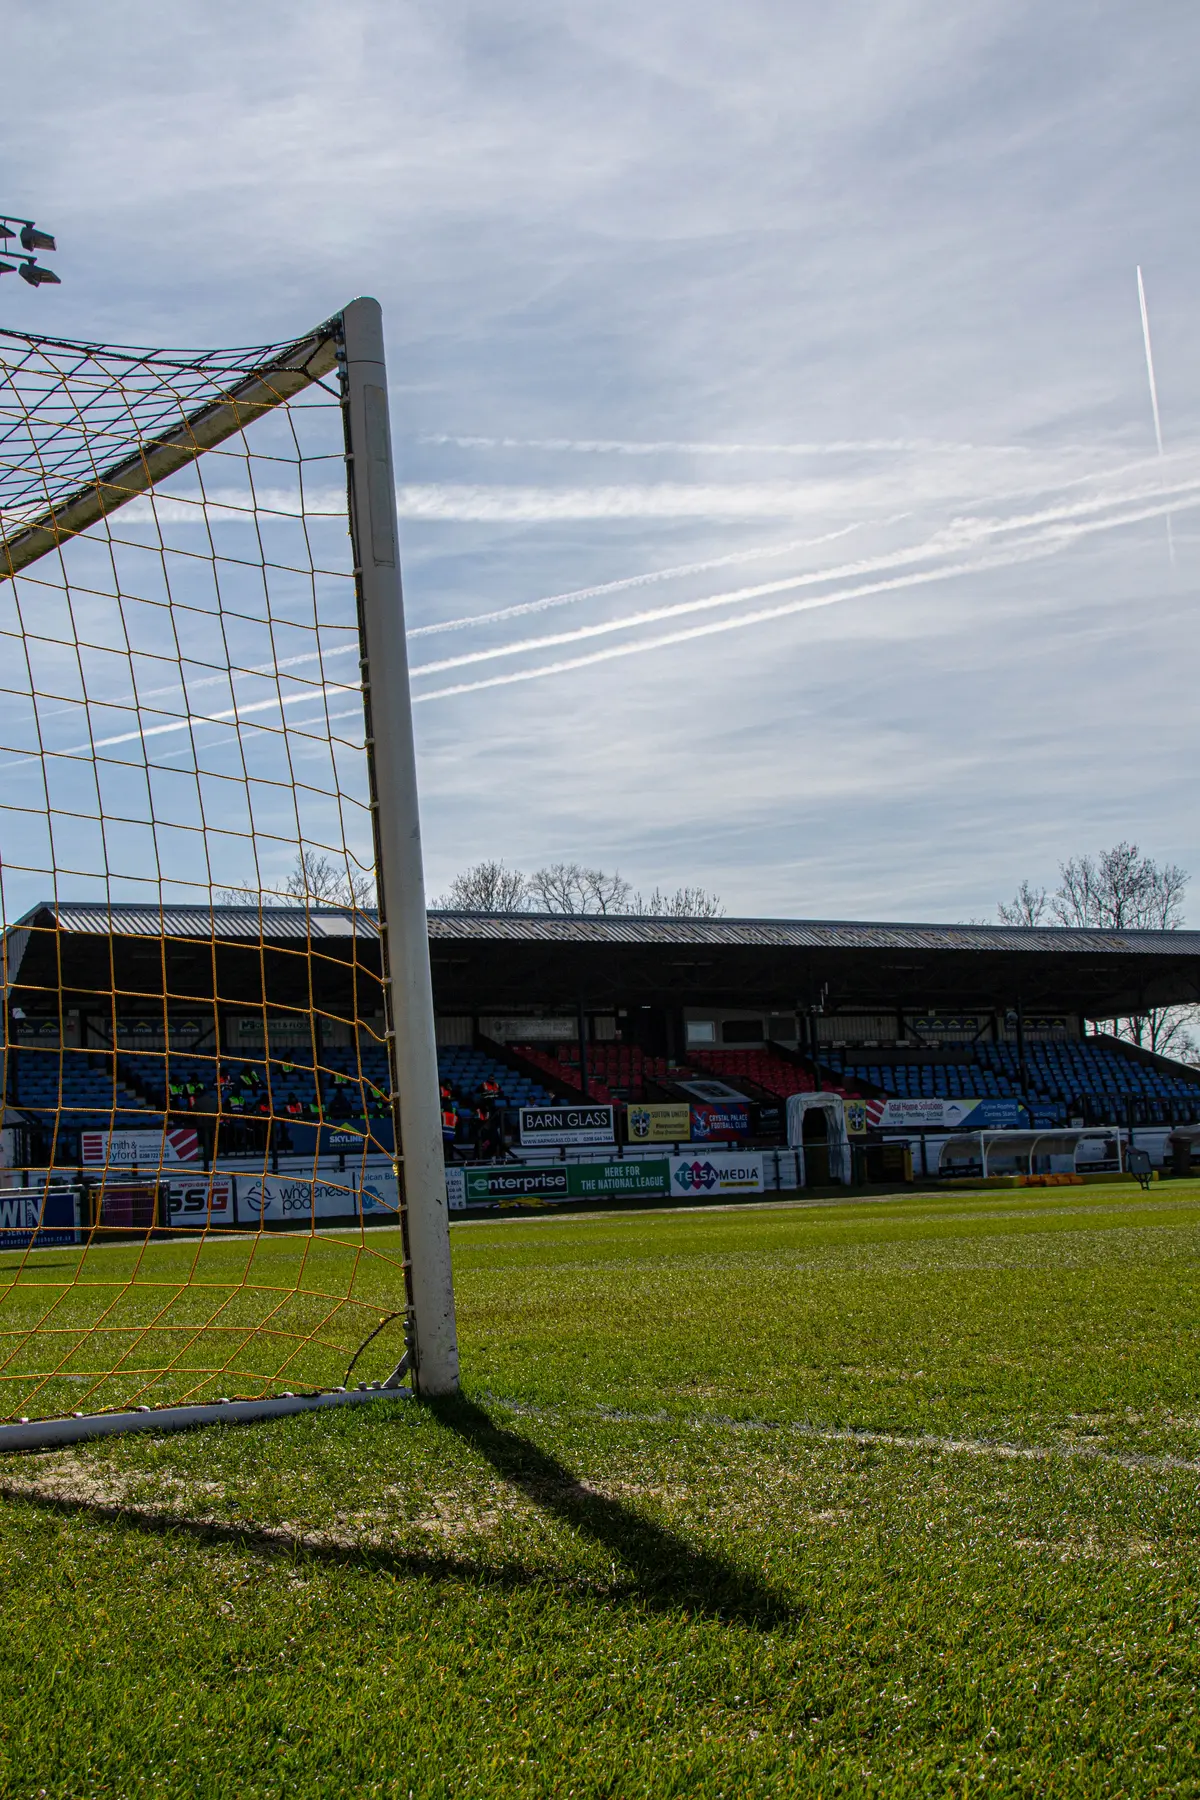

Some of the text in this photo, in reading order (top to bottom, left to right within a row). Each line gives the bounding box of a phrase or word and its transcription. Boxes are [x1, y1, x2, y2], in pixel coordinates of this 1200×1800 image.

[526, 1112, 608, 1128] BARN GLASS
[735, 1121, 748, 1129] CLUB
[131, 1141, 137, 1149] &
[329, 1135, 363, 1144] SKYLINE
[604, 1166, 641, 1178] HERE FOR
[677, 1169, 758, 1182] TELSA MEDIA
[474, 1173, 566, 1192] enterprise
[580, 1176, 664, 1191] THE NATIONAL LEAGUE
[7, 1228, 44, 1236] SERVICS
